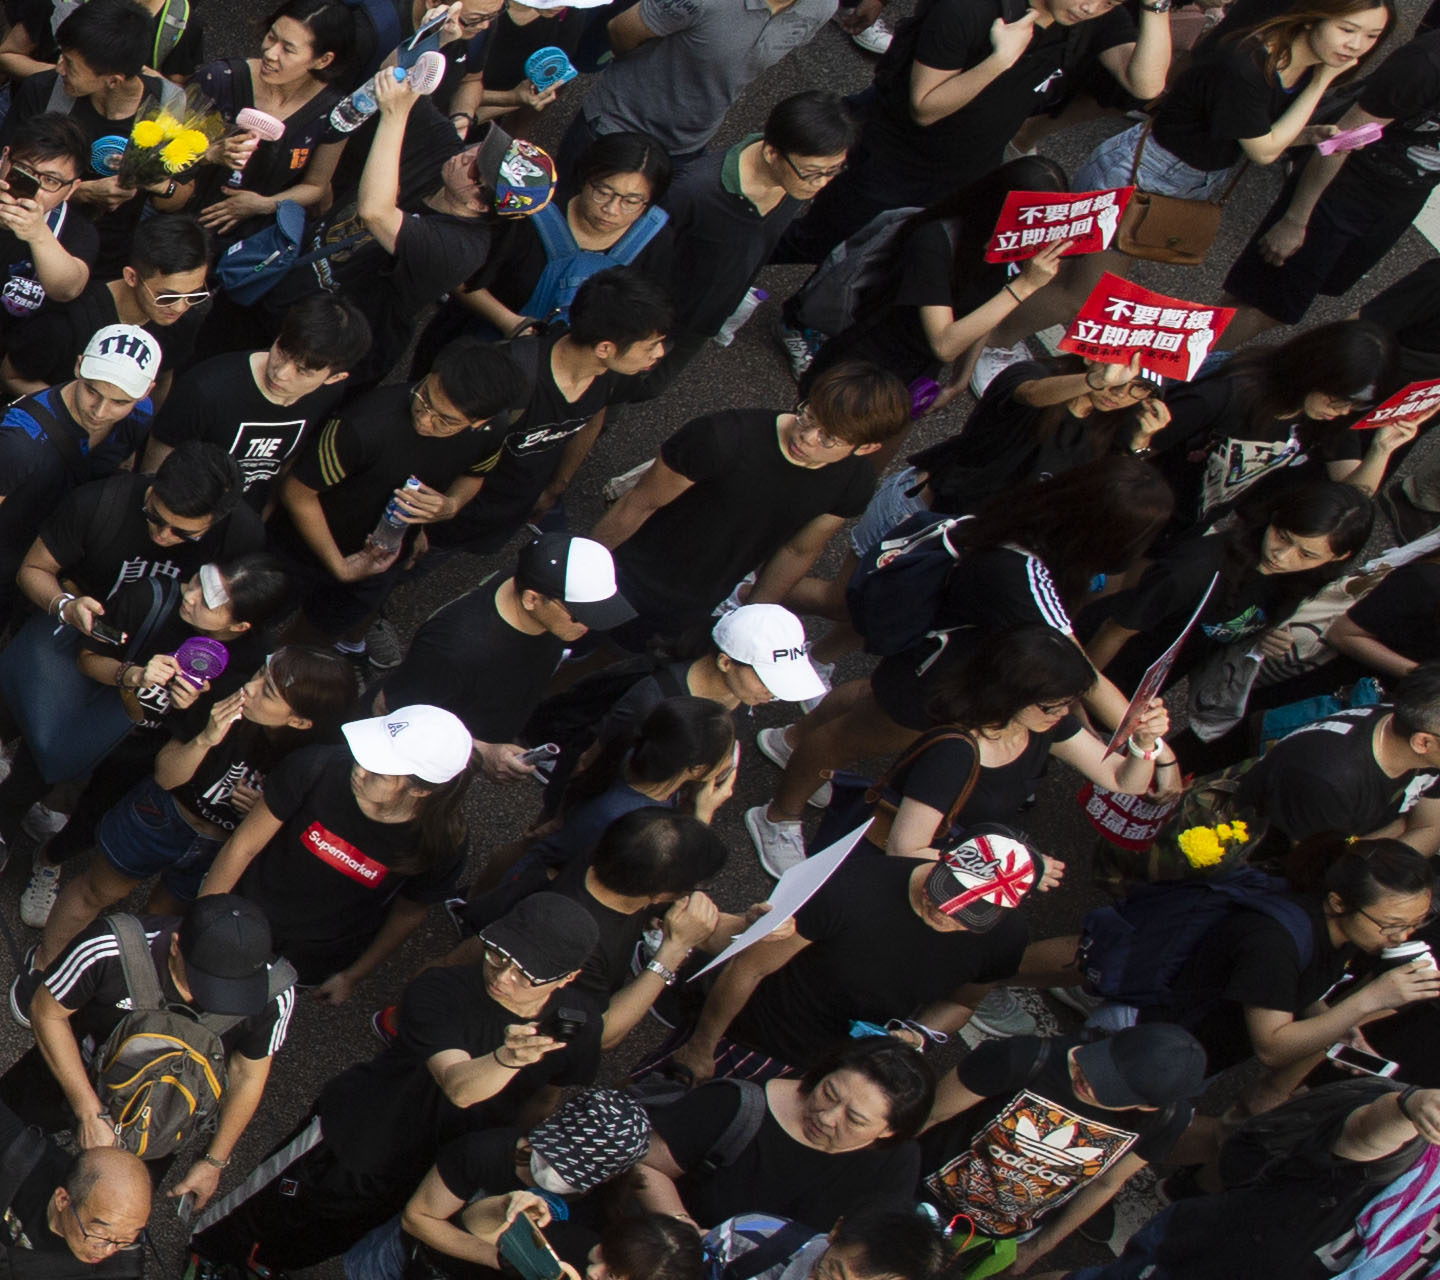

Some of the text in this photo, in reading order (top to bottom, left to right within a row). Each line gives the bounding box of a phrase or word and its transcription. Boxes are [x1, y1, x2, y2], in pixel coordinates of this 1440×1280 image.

[1017, 190, 1117, 228] 不要暫緩
[995, 215, 1093, 252] 立即撤回
[1104, 296, 1214, 333] 不要暫緩
[99, 333, 153, 371] THE
[1070, 318, 1185, 353] 立即撤回
[244, 437, 283, 459] THE
[308, 829, 381, 883] Supermarket
[988, 1143, 1073, 1189] adidas
